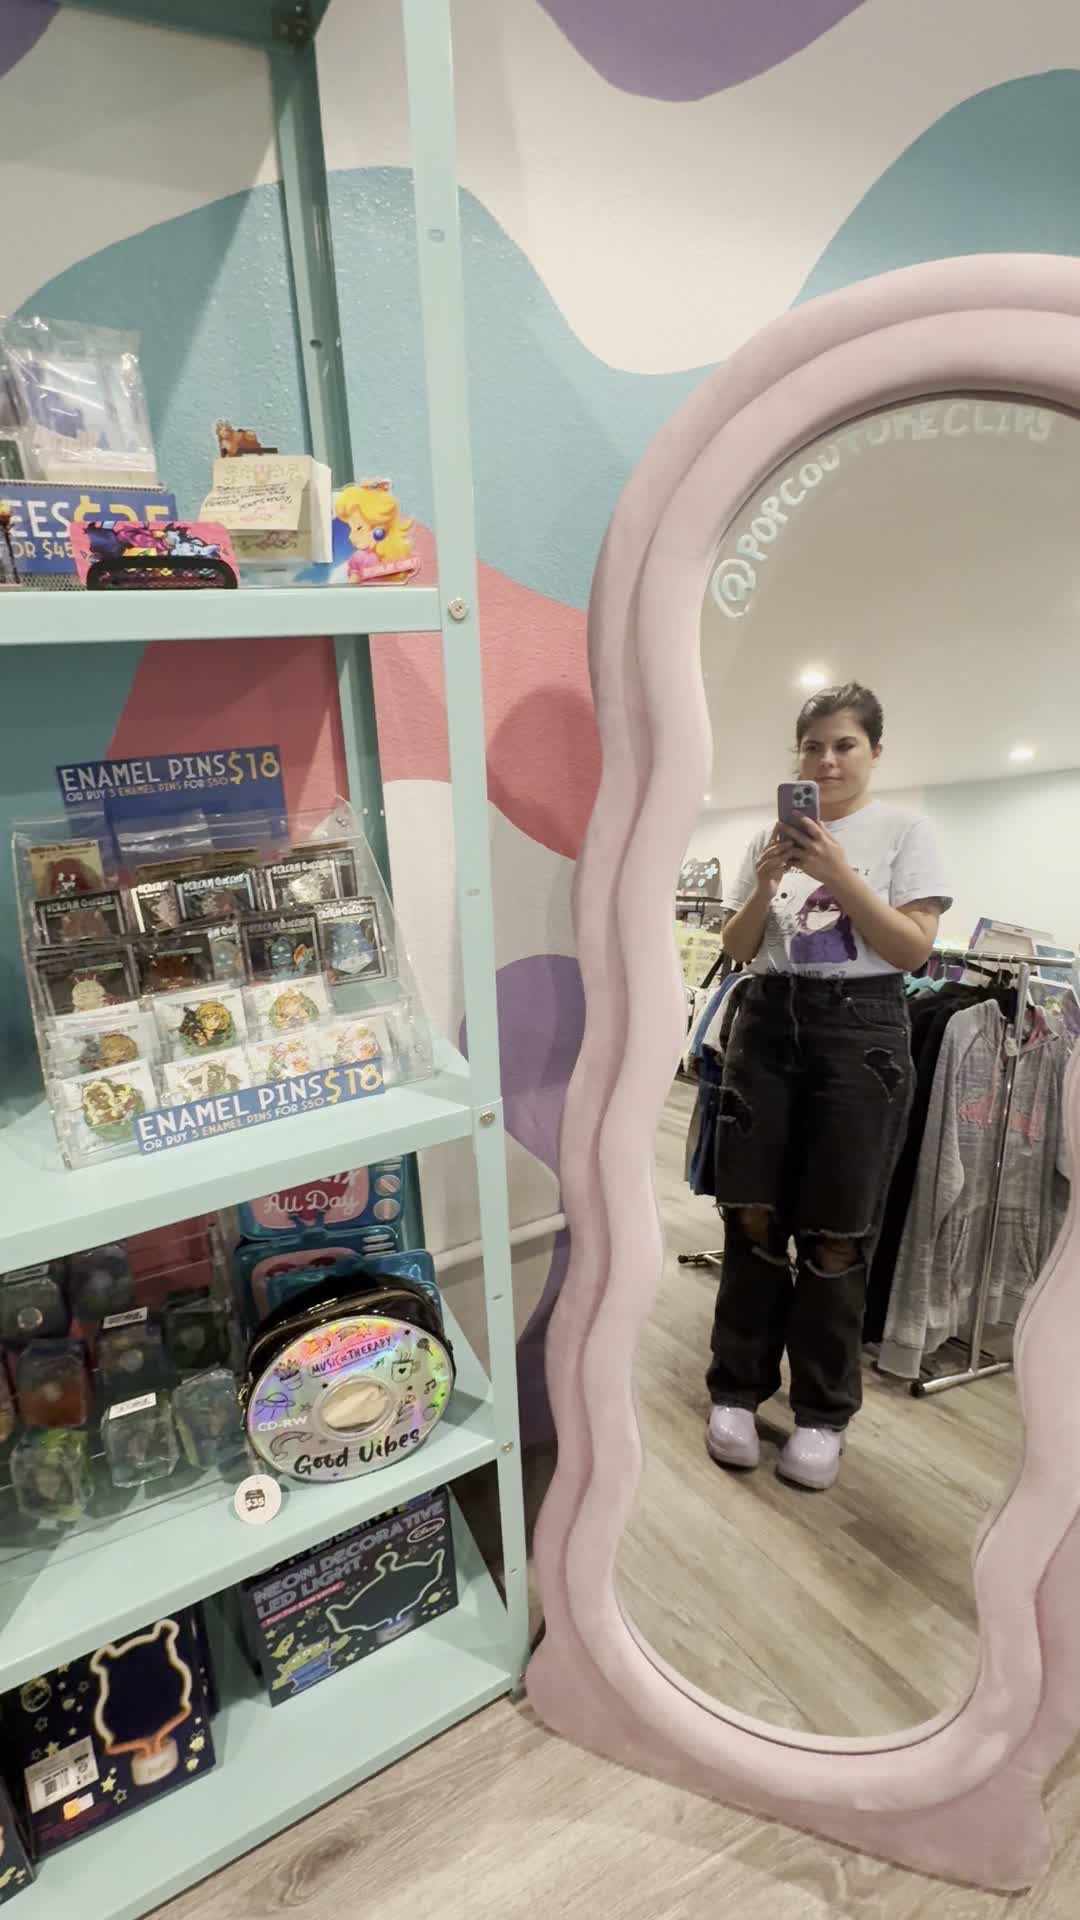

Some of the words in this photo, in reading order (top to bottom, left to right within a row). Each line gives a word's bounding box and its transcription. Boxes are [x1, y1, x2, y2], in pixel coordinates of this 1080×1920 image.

[61, 761, 160, 792] ENAMEL
[168, 754, 226, 780] PINS
[227, 751, 280, 784] $18
[66, 791, 84, 802] OR
[86, 788, 107, 800] BUY
[118, 783, 156, 797] ENAMEL
[158, 780, 181, 792] PINS
[183, 778, 205, 789] FOR
[138, 1095, 250, 1140] ENAMEL
[258, 1075, 322, 1110] PINS
[324, 1063, 383, 1104] $18
[143, 1139, 163, 1152] OR
[166, 1131, 188, 1146] BUY
[201, 1117, 243, 1137] ENAMEL
[246, 1110, 272, 1125] PINS
[275, 1104, 298, 1117] FOR
[302, 1097, 325, 1111] $50
[264, 1193, 303, 1213] All
[304, 1189, 359, 1214] Day
[257, 1415, 308, 1432] CD-RW
[294, 1447, 349, 1476] Good
[359, 1428, 421, 1463] Vibes
[253, 1565, 317, 1605] NEON
[319, 1500, 445, 1570] DECORATIVE
[255, 1590, 298, 1619] LED
[300, 1555, 364, 1602] LIGHT
